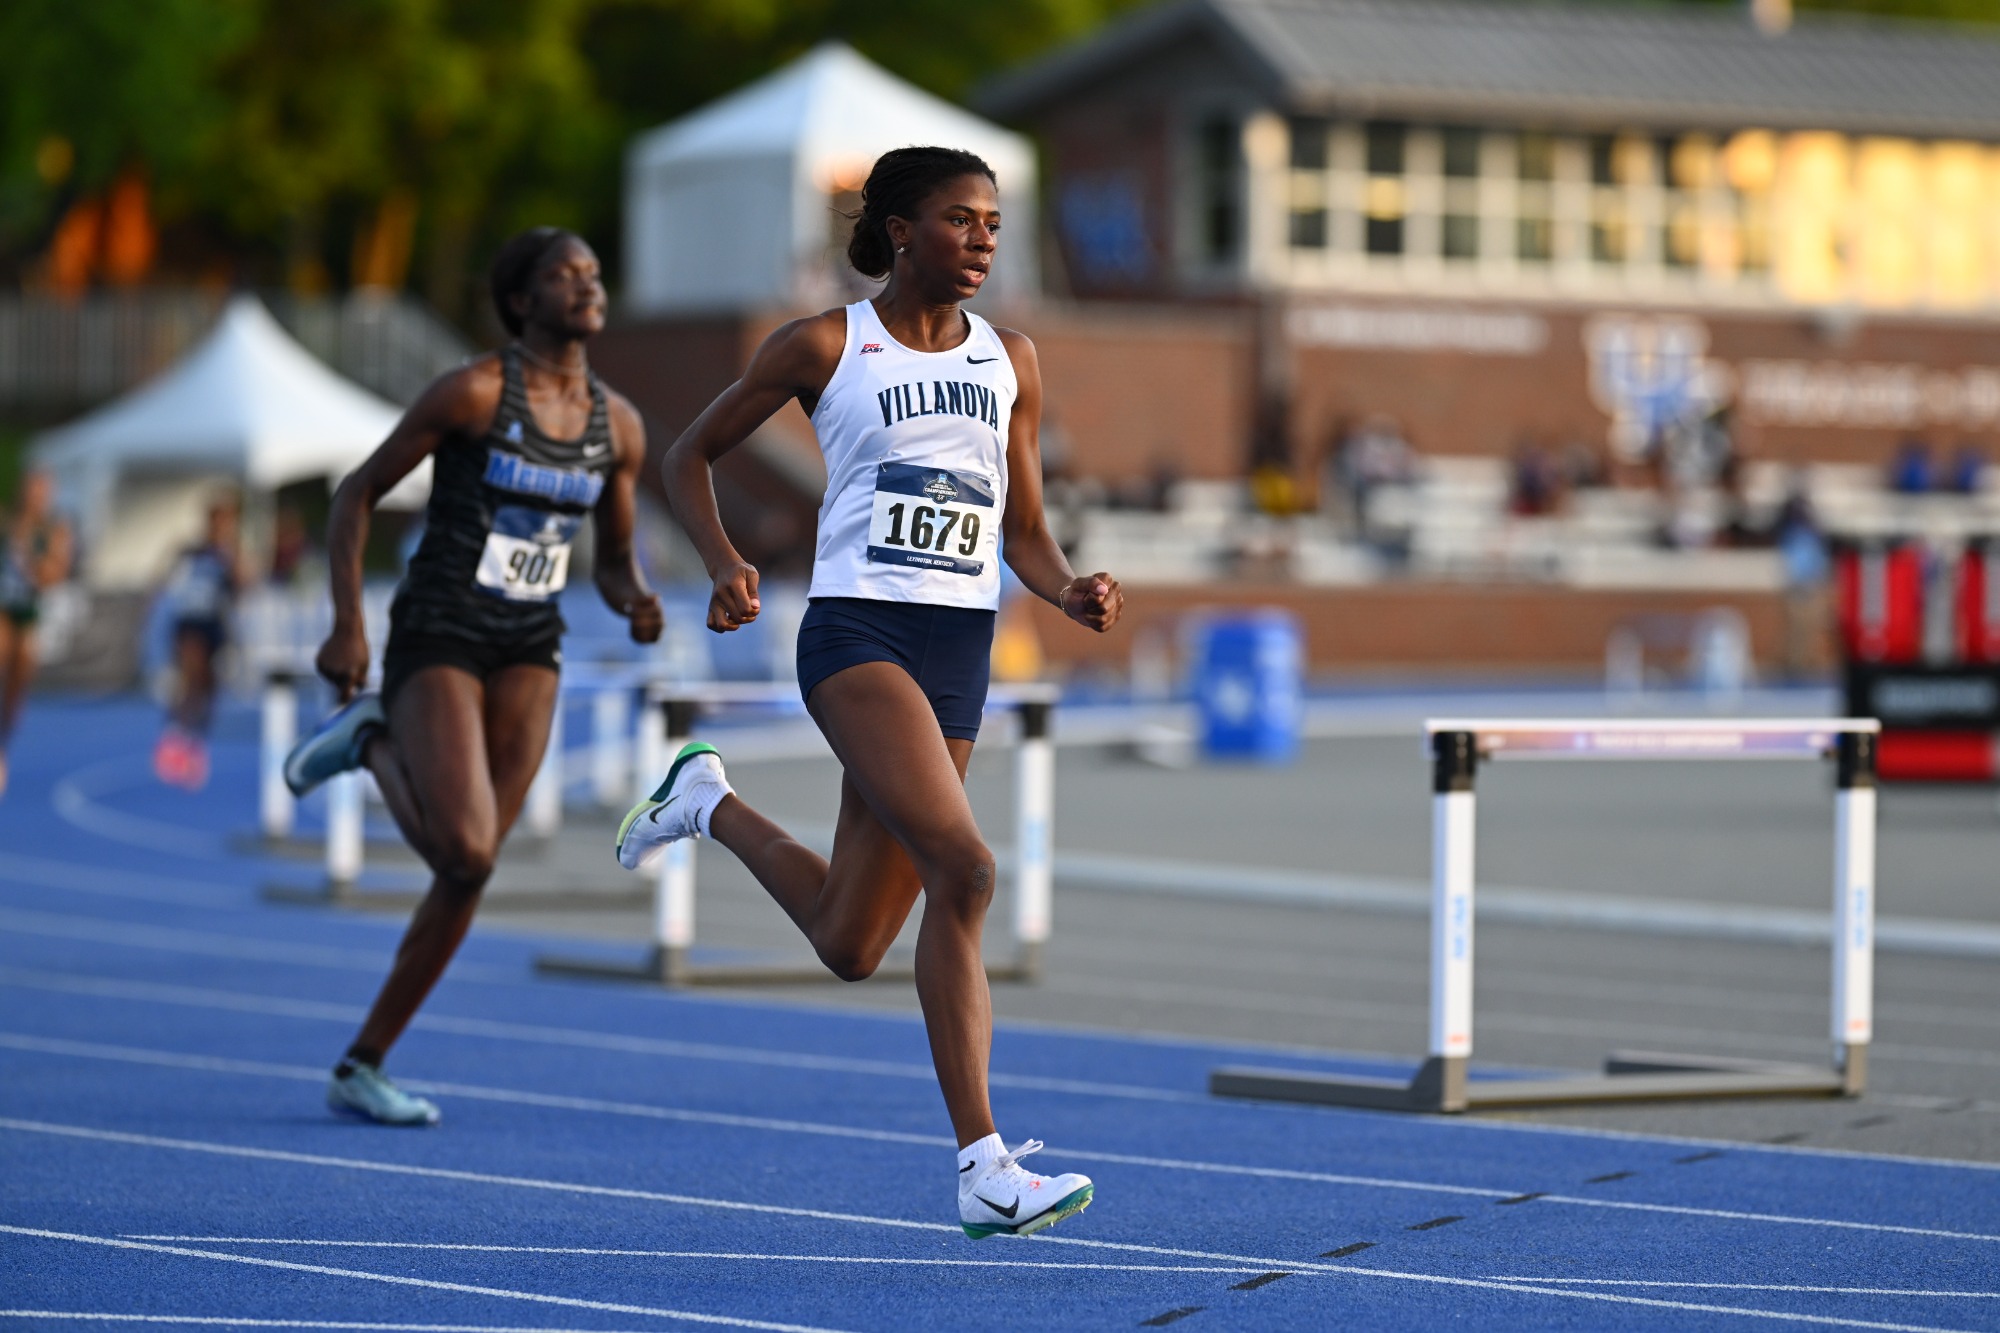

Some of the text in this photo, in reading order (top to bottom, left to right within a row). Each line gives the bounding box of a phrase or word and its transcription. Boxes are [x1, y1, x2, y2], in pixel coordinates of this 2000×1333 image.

[877, 380, 999, 432] VILLANOVA
[484, 450, 605, 504] Memph
[884, 502, 981, 556] 1679
[505, 549, 561, 585] 901
